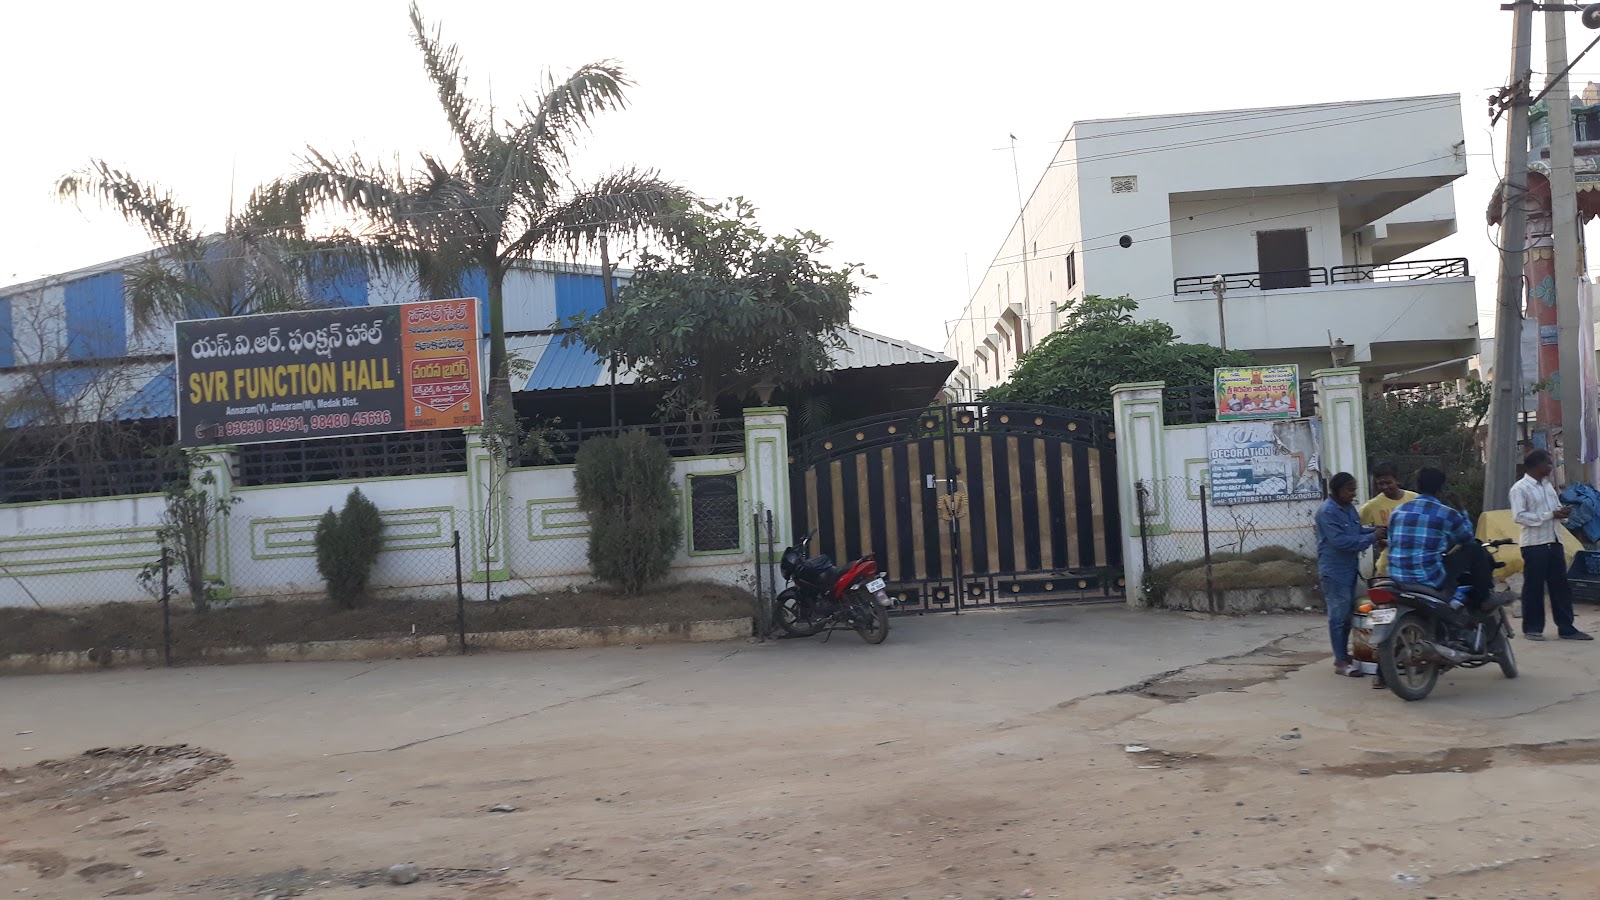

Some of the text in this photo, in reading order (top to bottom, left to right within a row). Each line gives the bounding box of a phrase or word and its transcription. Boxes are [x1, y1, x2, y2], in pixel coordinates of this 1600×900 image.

[288, 322, 343, 359] ఫంక్షన్
[346, 319, 383, 347] హాల్
[189, 358, 395, 404] SVR FUNCTION HALL
[413, 363, 441, 380] చందన
[226, 396, 359, 416] Annaram(V), Jinnaram(M), Medak Dist.
[226, 419, 264, 437] 93930
[266, 416, 308, 434] 89431,
[310, 414, 349, 430] 98480
[352, 410, 391, 427] 45636
[1211, 446, 1271, 459] DECORATION
